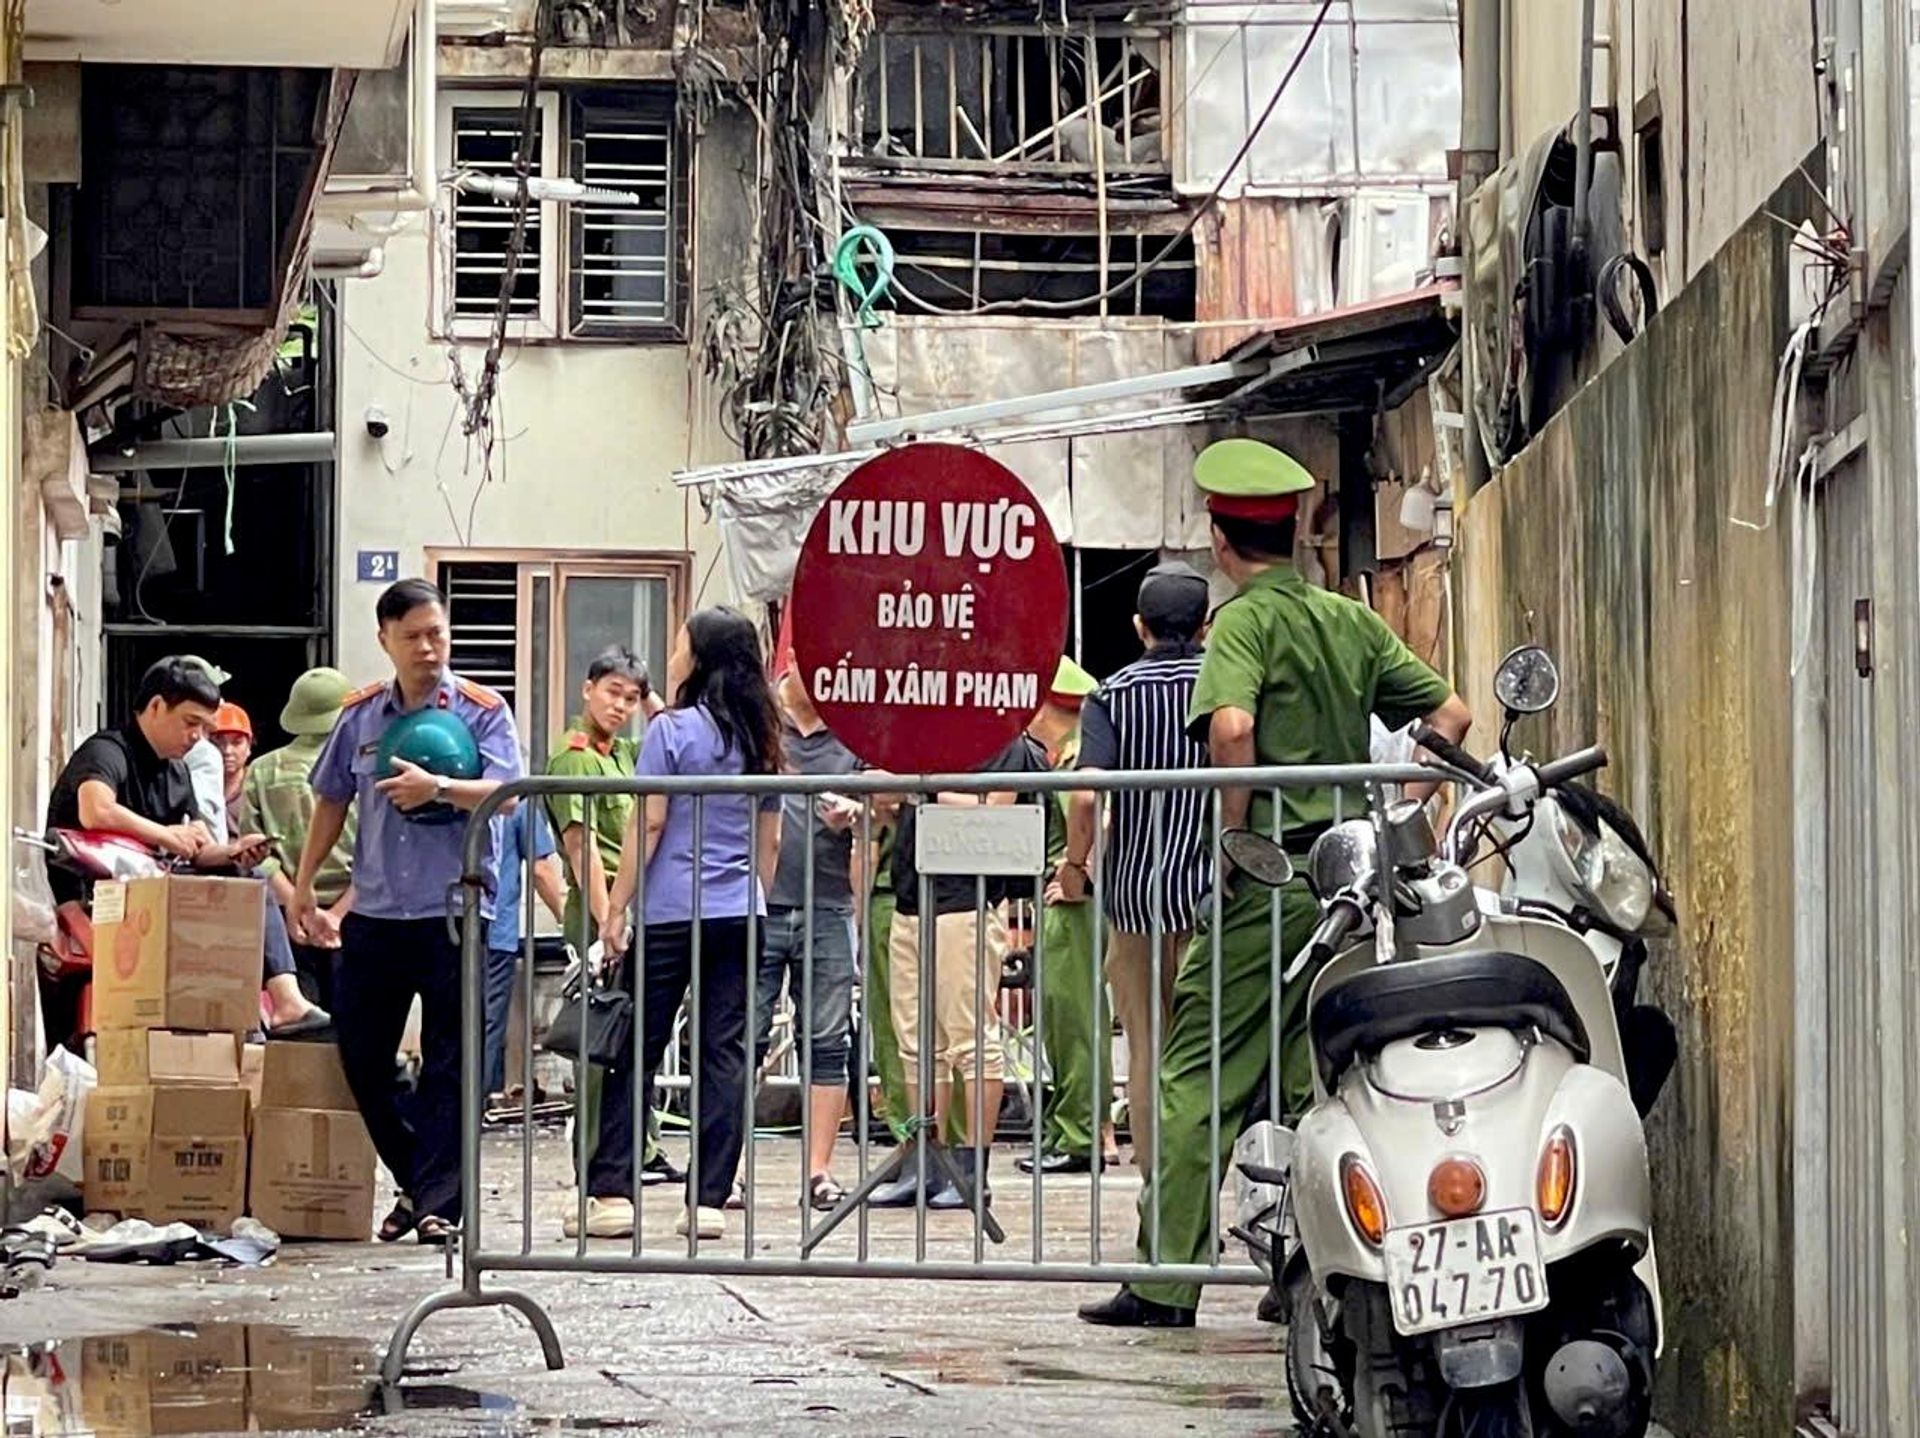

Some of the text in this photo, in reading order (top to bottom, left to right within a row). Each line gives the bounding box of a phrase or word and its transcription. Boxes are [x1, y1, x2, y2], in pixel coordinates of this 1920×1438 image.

[829, 497, 1035, 573] KHU VỰC
[877, 579, 975, 640] BẢO VỆ
[813, 651, 1038, 716] CẤM XÂM PHẠM
[1402, 1262, 1536, 1325] 047.70
